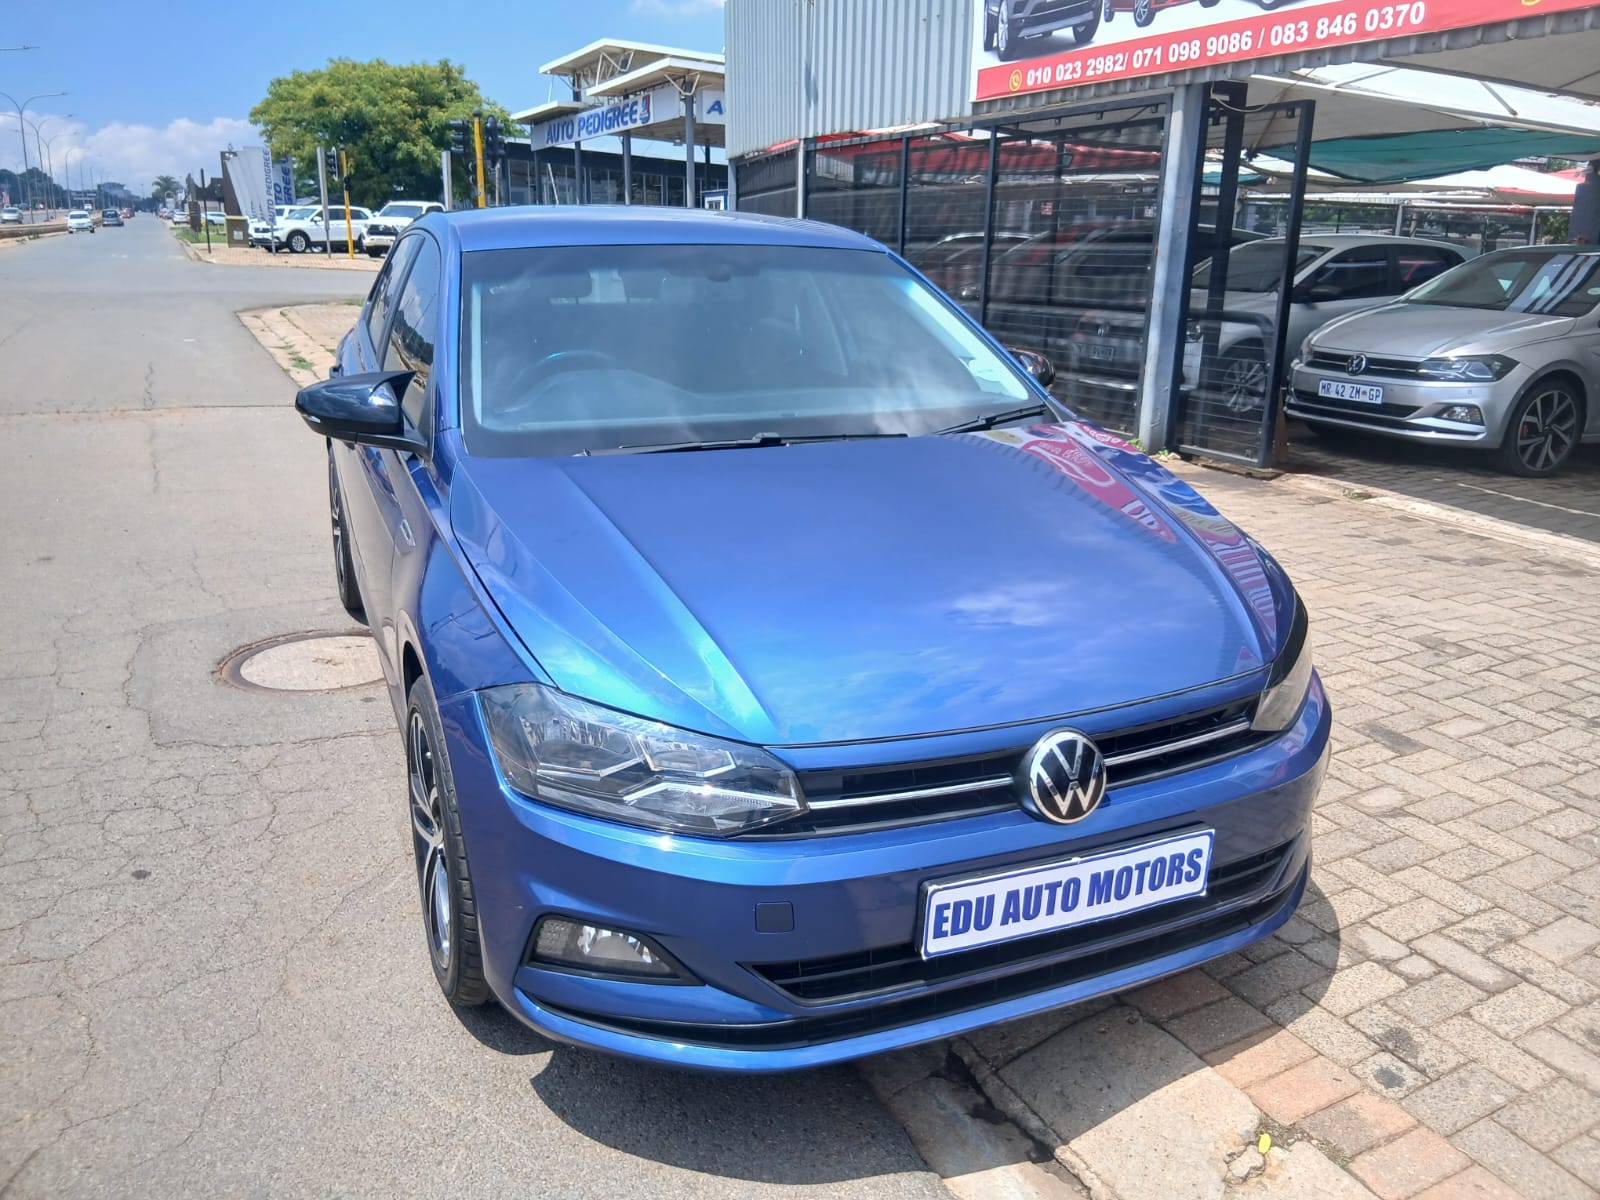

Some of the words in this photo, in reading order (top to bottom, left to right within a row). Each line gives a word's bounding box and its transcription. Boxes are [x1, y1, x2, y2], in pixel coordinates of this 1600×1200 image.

[1026, 67, 1051, 86] 010
[1055, 61, 1082, 81] 023
[1132, 46, 1162, 69] 071
[1168, 39, 1200, 63] 098
[1206, 30, 1253, 56] 9086
[1270, 21, 1309, 46] 083
[1315, 13, 1357, 40] 846
[1364, 1, 1425, 32] 0370
[546, 121, 575, 144] AUTO
[577, 100, 638, 137] PEDIGREE
[262, 148, 273, 196] PEDIGREE
[1335, 384, 1346, 397] 42
[1368, 388, 1381, 401] GP
[932, 894, 995, 939] EDU
[999, 876, 1082, 926] AUTO
[1086, 847, 1204, 907] MOTORS
